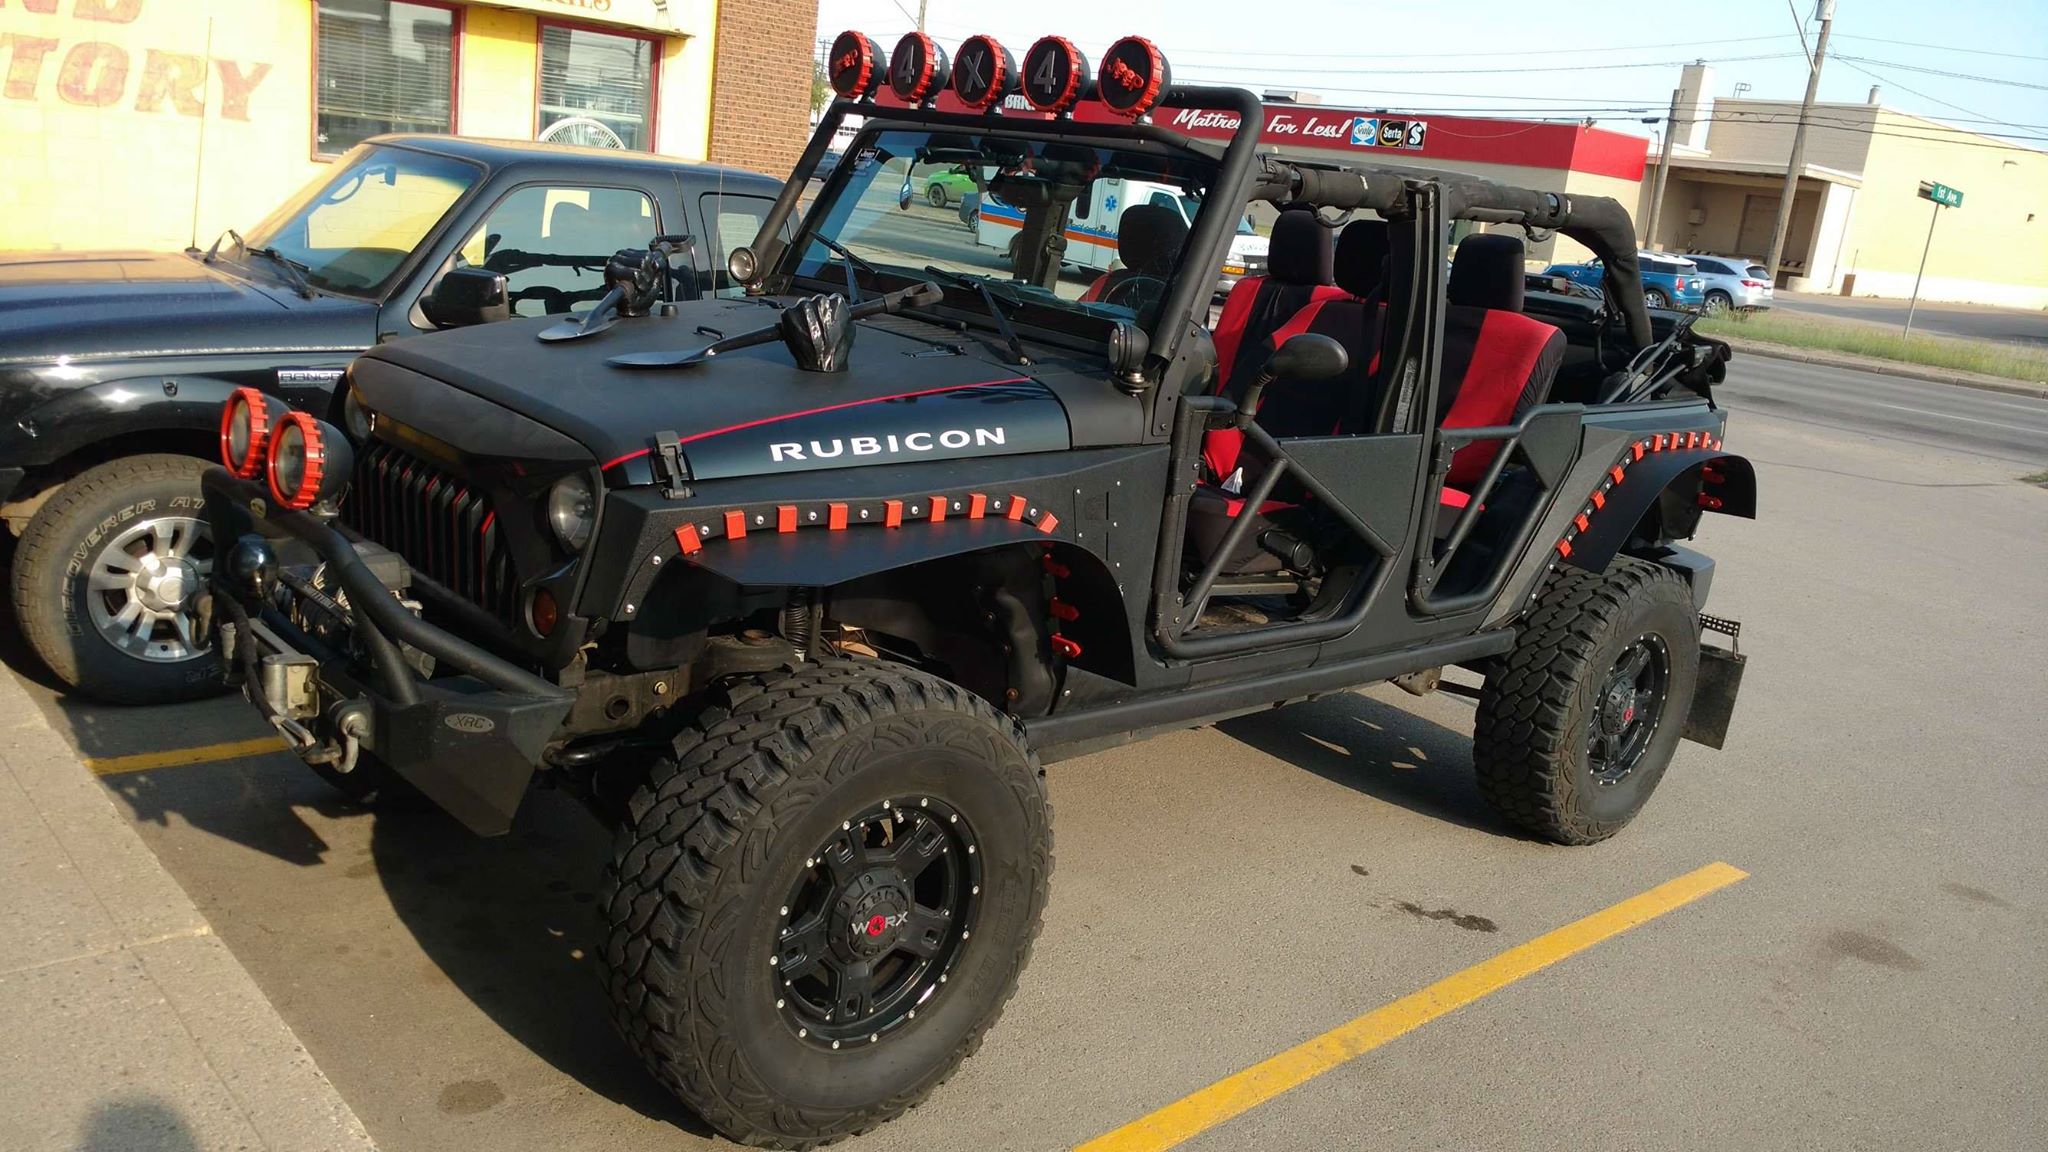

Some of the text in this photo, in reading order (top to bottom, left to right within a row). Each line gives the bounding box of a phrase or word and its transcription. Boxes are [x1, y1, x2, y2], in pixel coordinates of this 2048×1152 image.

[1, 32, 273, 122] TORY
[898, 44, 915, 84] 4
[962, 50, 986, 93] X
[1033, 50, 1056, 94] 4
[1107, 56, 1145, 92] Jeep
[1004, 94, 1036, 111] BRIC
[1266, 115, 1299, 135] For
[1302, 117, 1353, 138] Less!
[1383, 126, 1403, 139] Serta
[1937, 185, 1947, 199] 1st
[769, 426, 1006, 462] RUBICON
[456, 715, 486, 729] XRC
